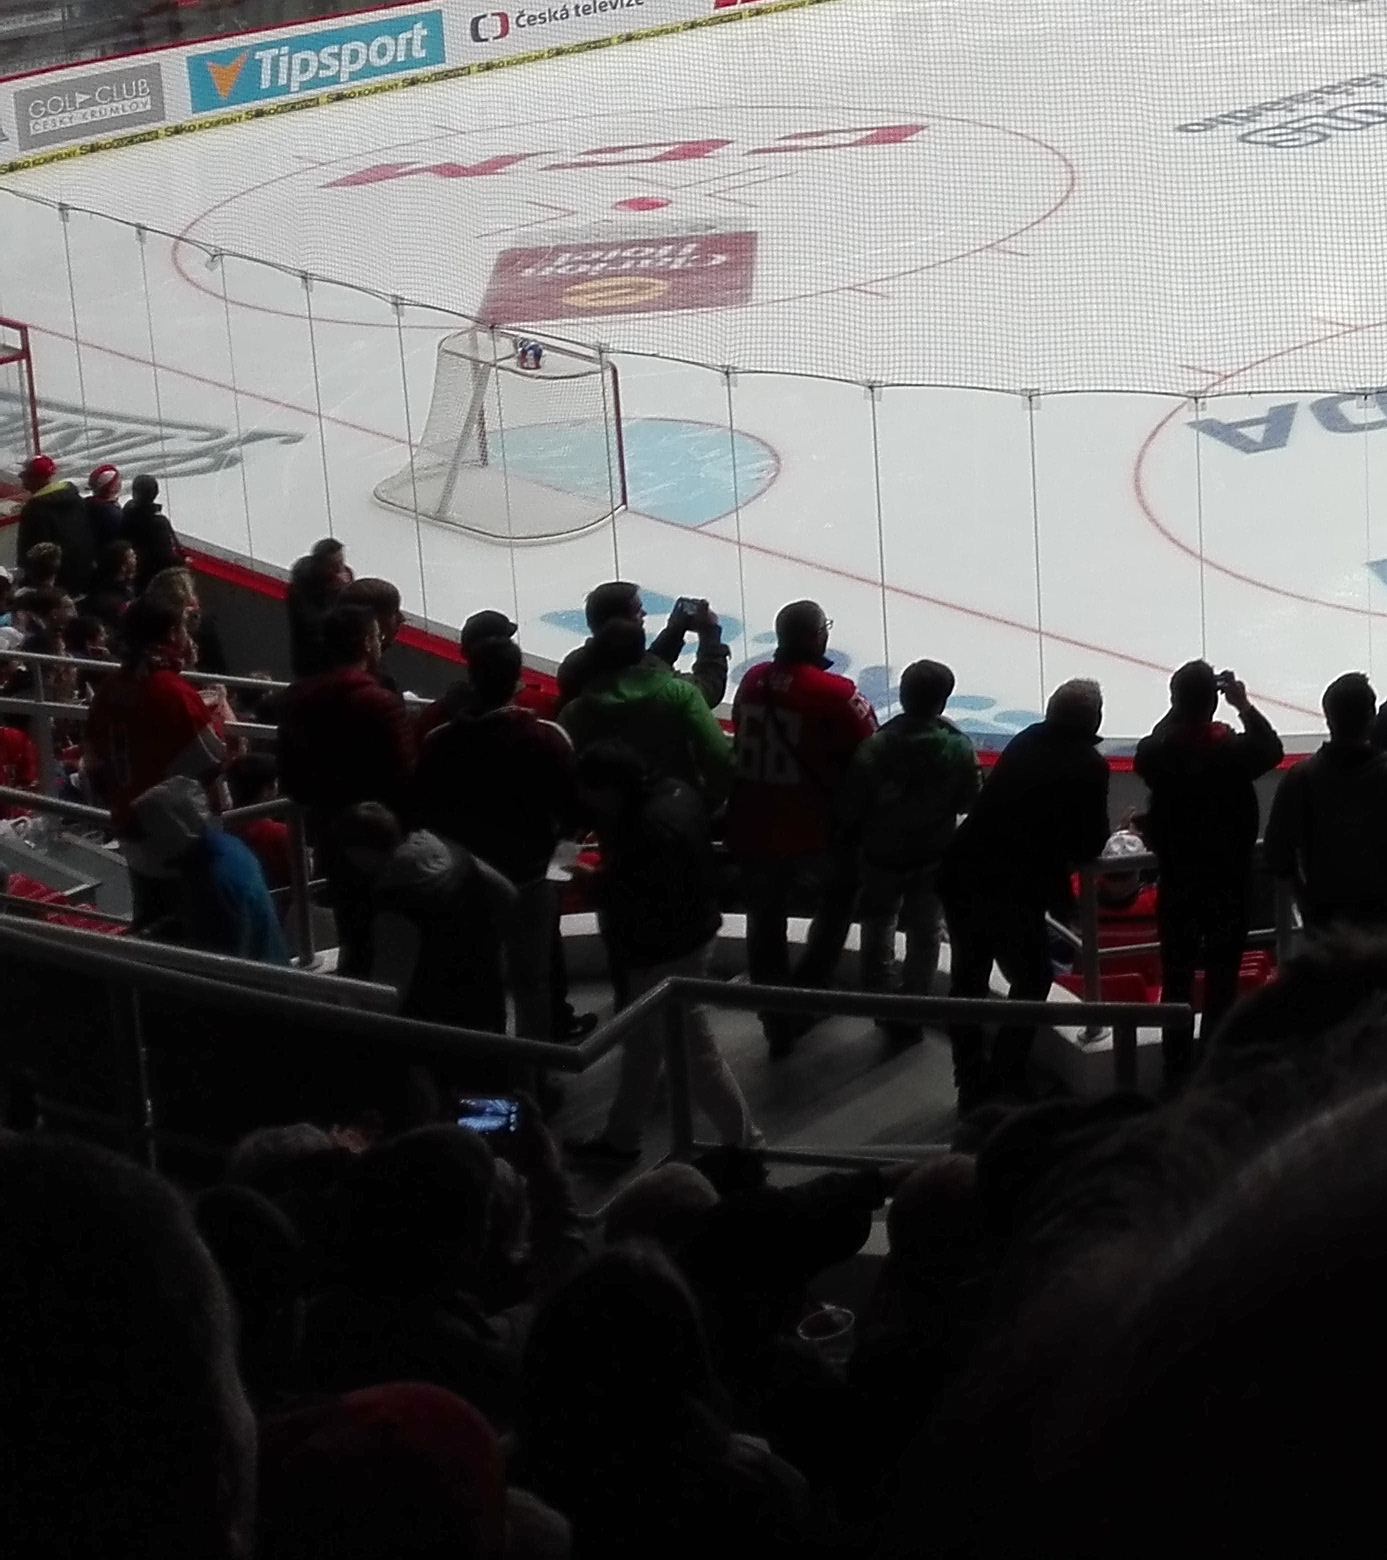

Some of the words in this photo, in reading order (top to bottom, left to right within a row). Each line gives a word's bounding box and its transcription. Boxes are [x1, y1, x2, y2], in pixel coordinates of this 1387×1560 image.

[515, 4, 570, 30] Česká
[253, 20, 429, 93] Tipsport
[95, 78, 151, 106] CLUB
